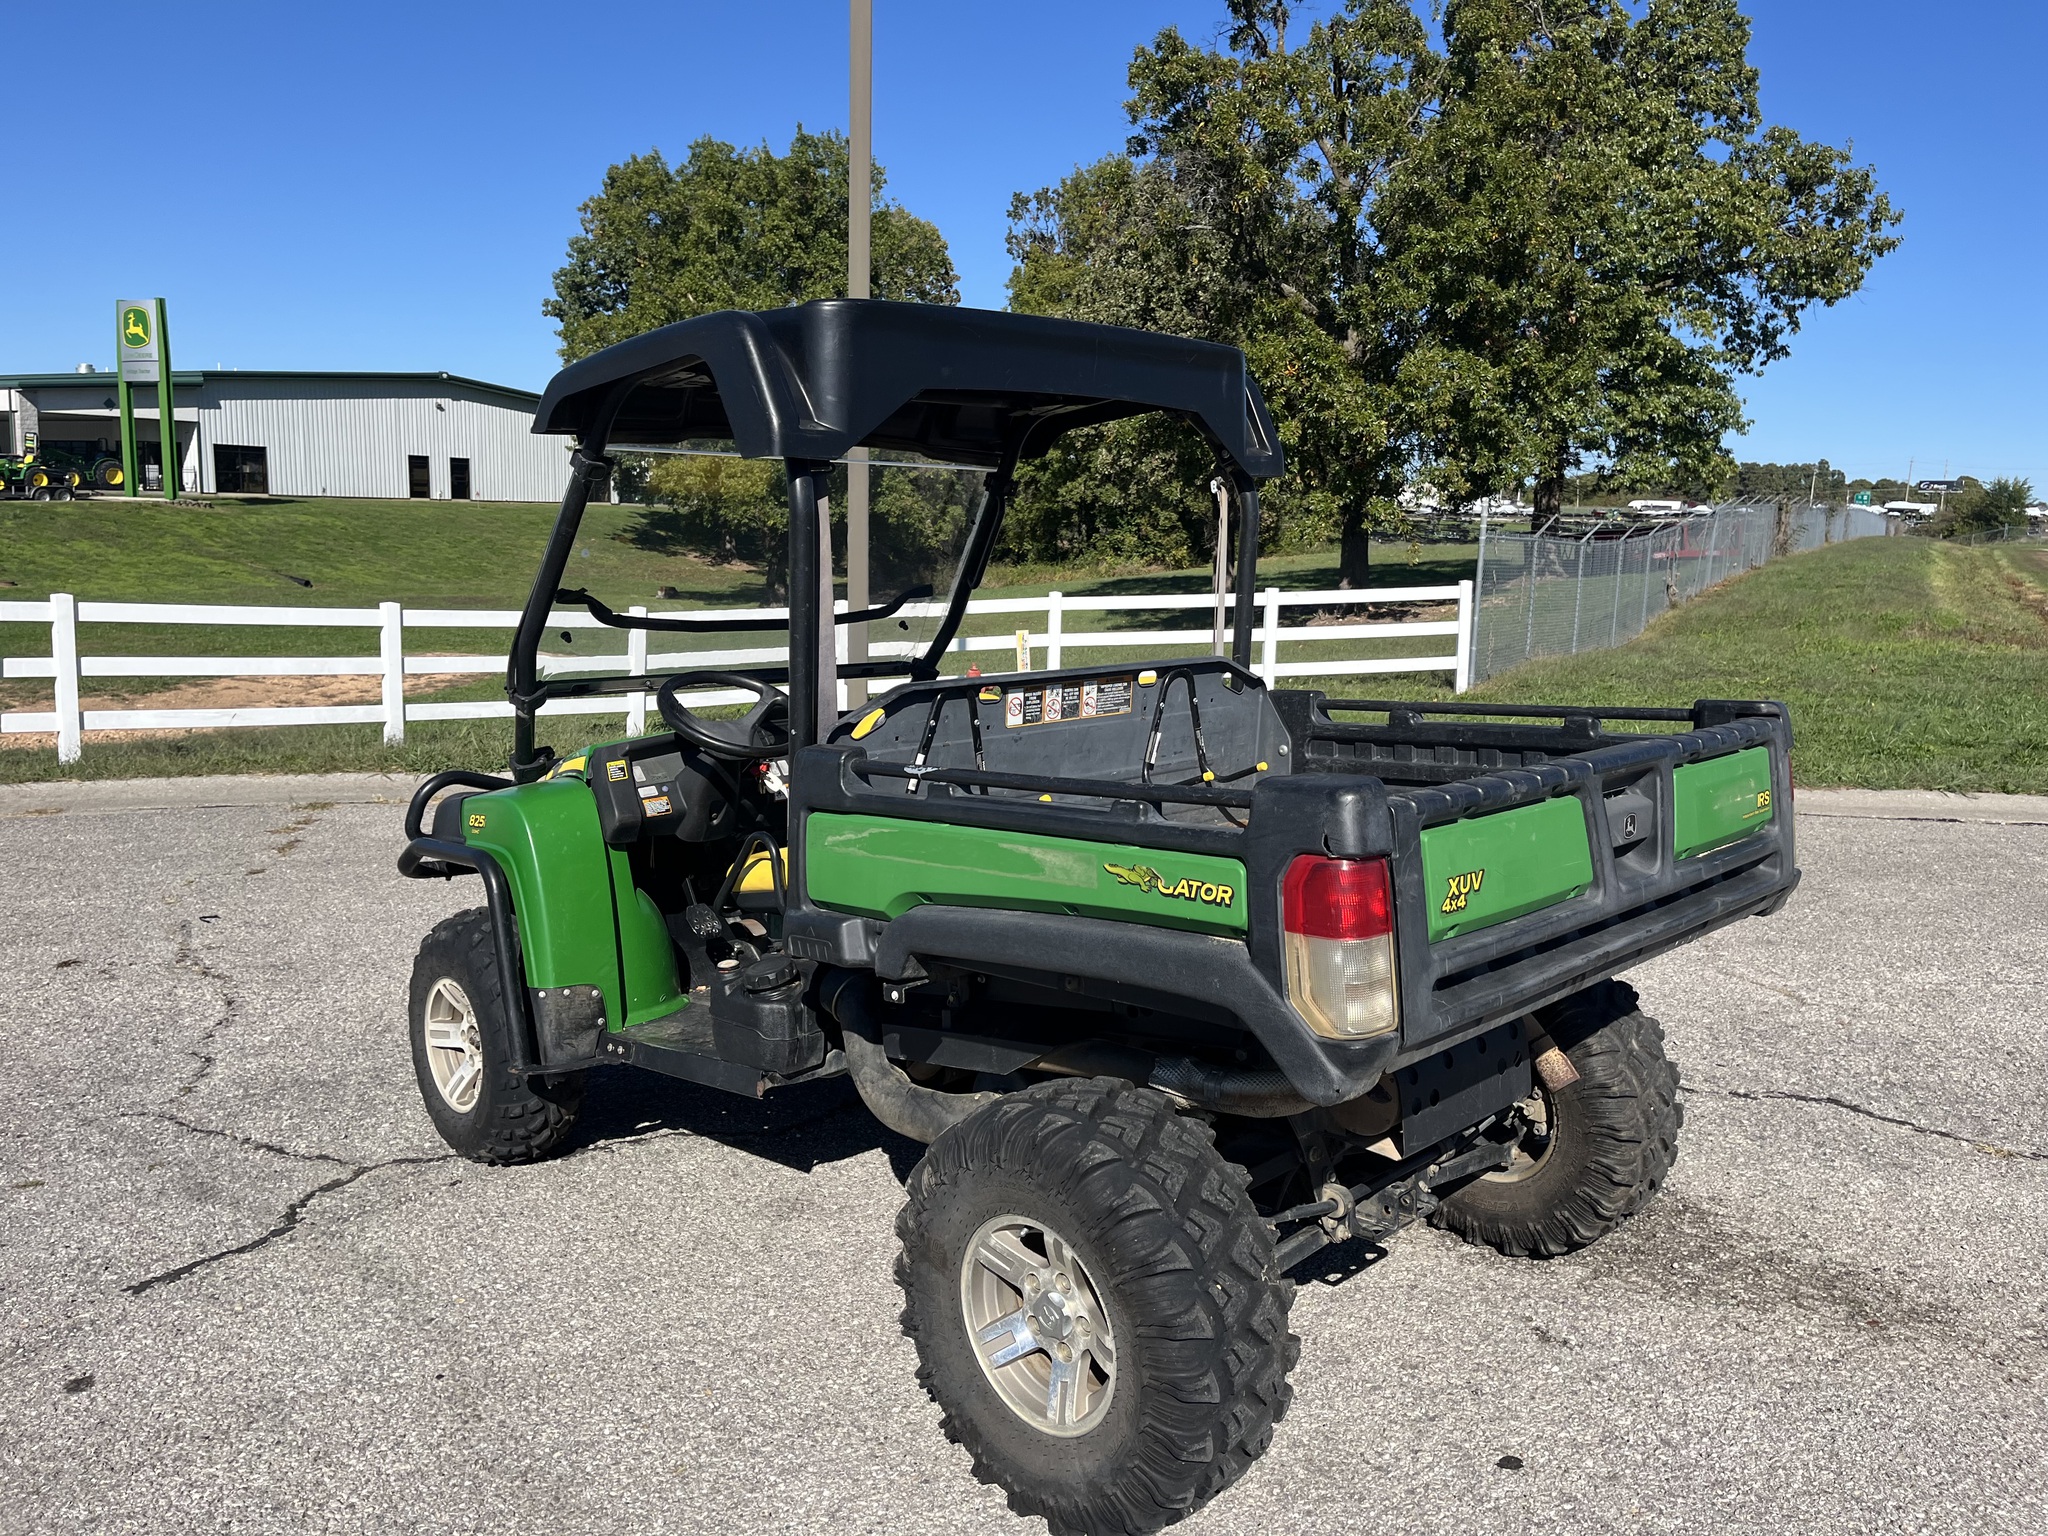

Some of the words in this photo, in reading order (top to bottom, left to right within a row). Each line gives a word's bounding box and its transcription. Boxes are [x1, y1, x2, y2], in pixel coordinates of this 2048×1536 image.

[1757, 790, 1770, 808] IRS
[1447, 869, 1484, 898] XUV
[1441, 894, 1467, 913] 4x4
